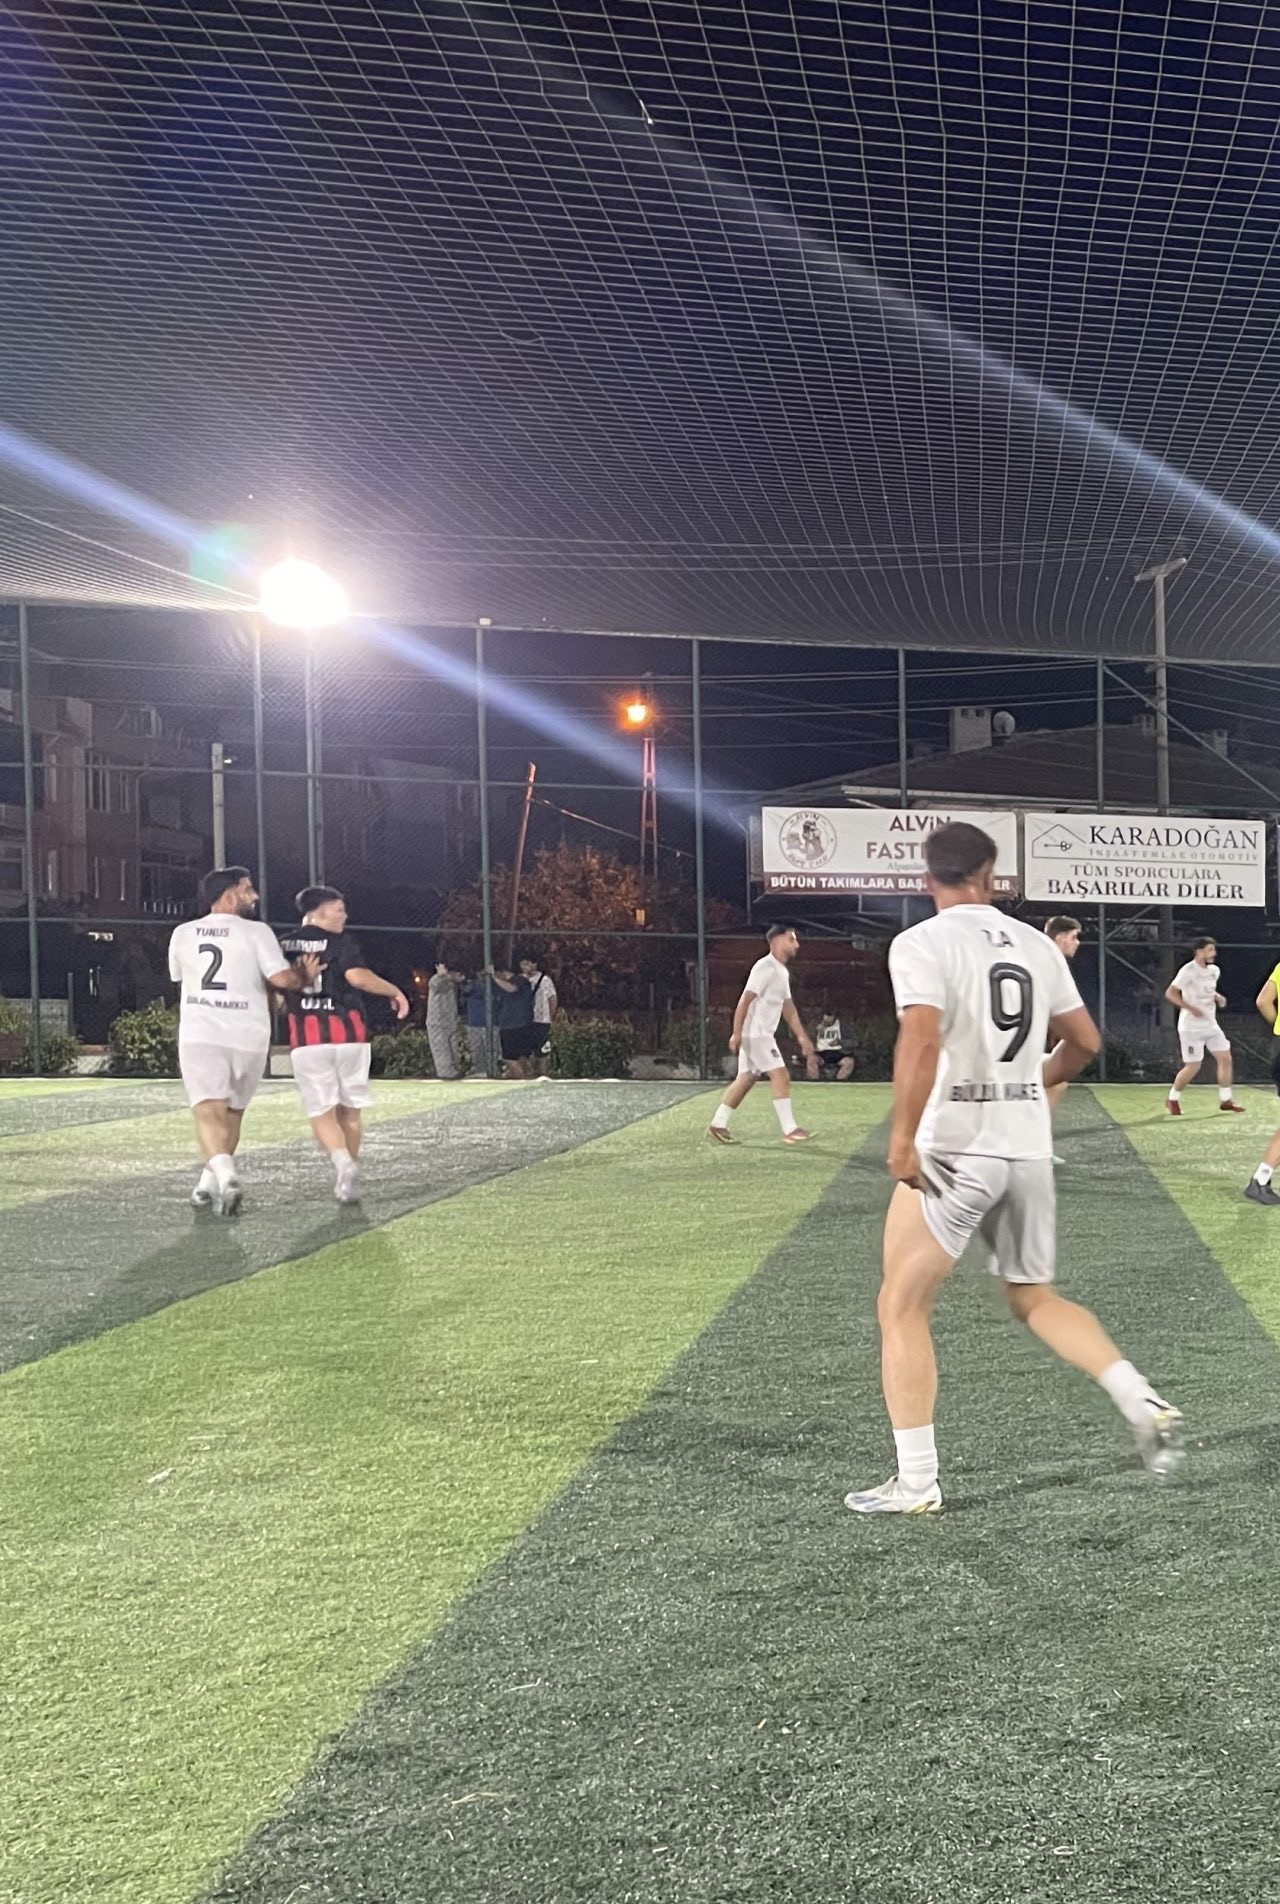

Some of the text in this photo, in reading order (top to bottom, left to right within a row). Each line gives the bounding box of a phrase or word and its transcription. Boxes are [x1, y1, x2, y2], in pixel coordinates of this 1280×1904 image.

[1089, 825, 1259, 849] KARADOĞAN
[1070, 863, 1222, 880] TÜM SPORCULARA
[770, 875, 816, 888] BÜTÜN
[819, 877, 895, 889] TAKIMLARA
[1048, 879, 1244, 899] BAŞARILAR DİLER
[196, 927, 230, 938] YUNUS
[198, 943, 227, 991] 2
[989, 962, 1033, 1063] 9
